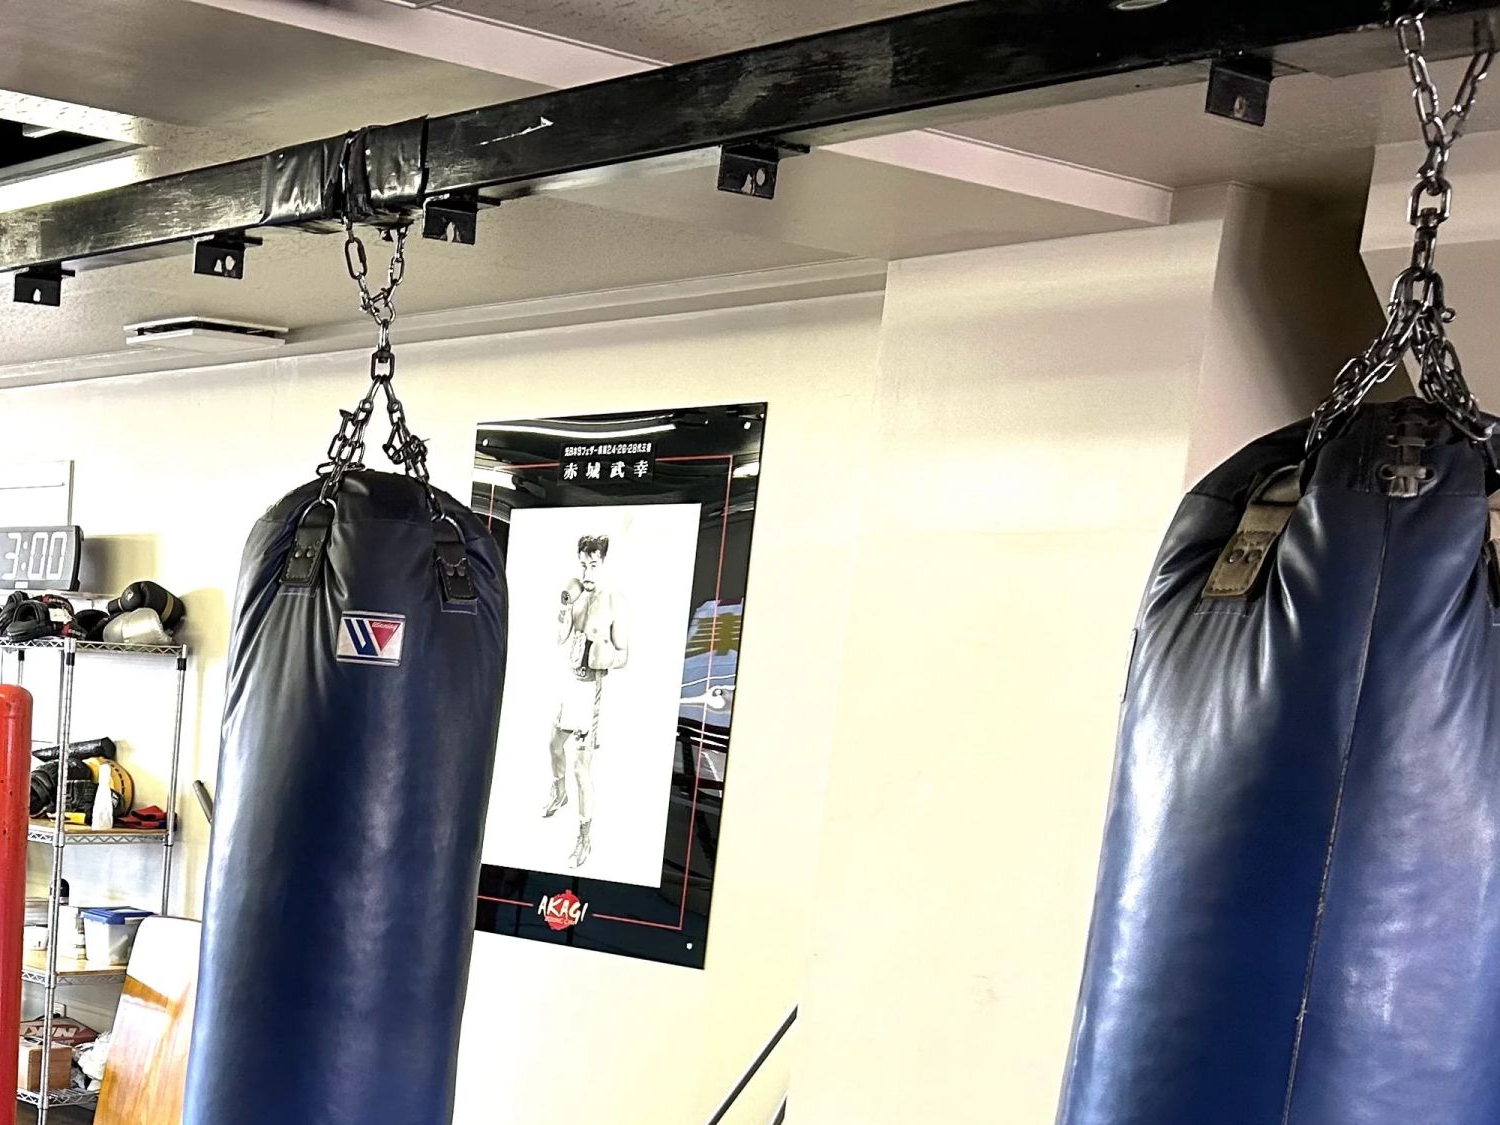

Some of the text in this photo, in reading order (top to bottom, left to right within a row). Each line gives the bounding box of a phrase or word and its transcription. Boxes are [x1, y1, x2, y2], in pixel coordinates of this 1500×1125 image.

[563, 460, 649, 479] 赤城武幸
[2, 531, 67, 580] 3:00
[538, 895, 589, 925] AKAGI
